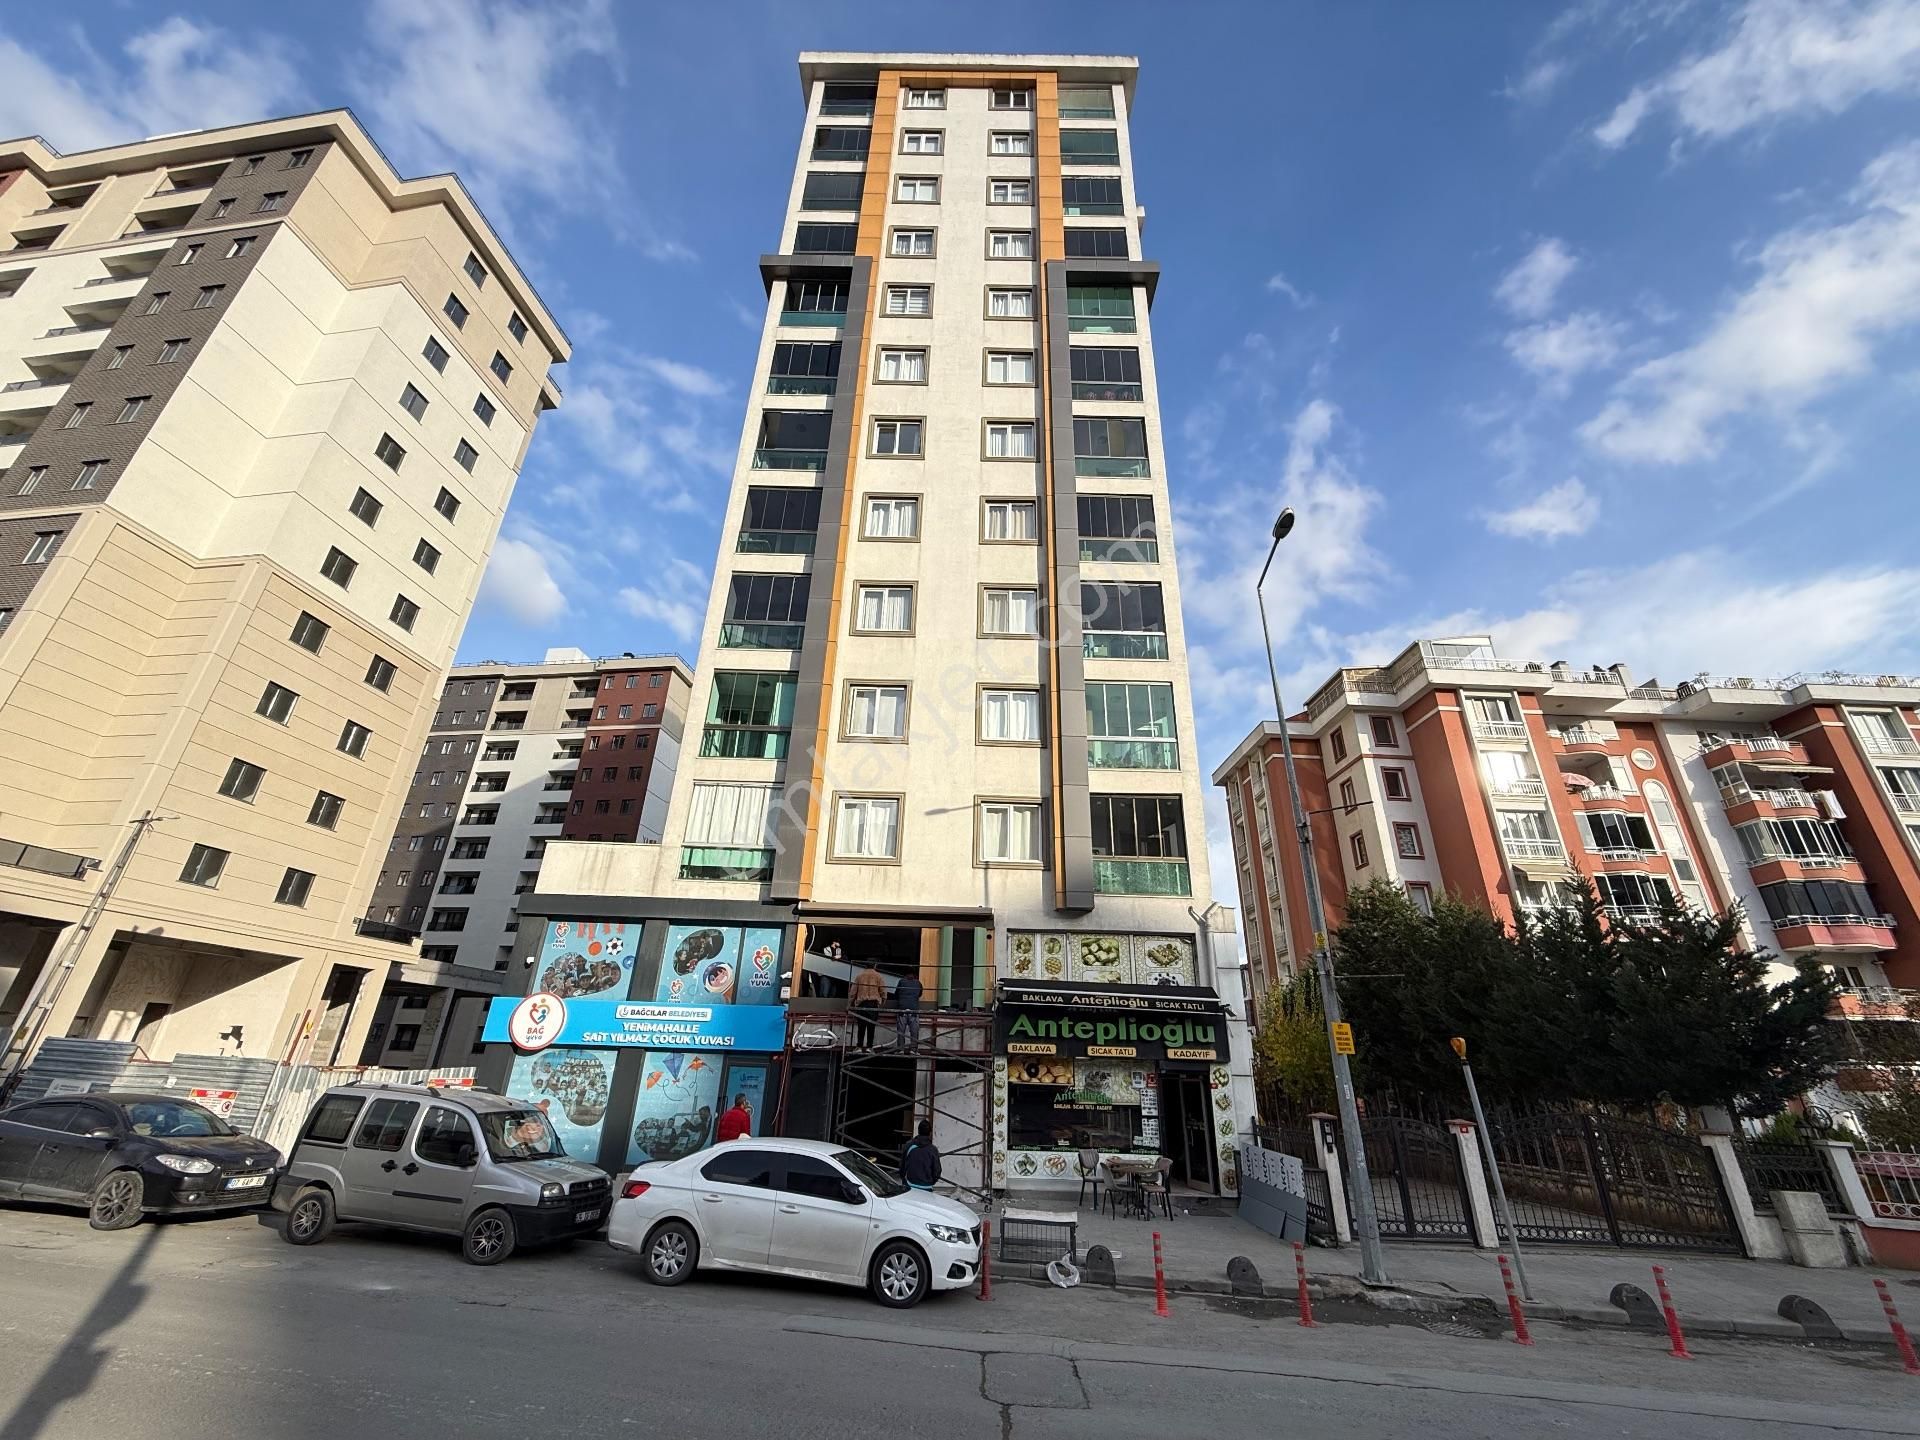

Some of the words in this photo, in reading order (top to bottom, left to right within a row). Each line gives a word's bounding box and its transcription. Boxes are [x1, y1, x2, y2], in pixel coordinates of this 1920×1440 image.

[1022, 994, 1064, 1003] BAKLAVA
[1070, 994, 1149, 1008] Anteplioğlu
[1155, 1001, 1181, 1010] SICAK
[1182, 1002, 1205, 1011] TATLI
[630, 1008, 668, 1017] BAĞCILAR
[526, 1026, 545, 1034] BAĞ
[1008, 1014, 1216, 1048] Anteplioğlu
[610, 1032, 650, 1044] YILMAZ
[652, 1034, 692, 1045] ÇOCUK
[693, 1035, 735, 1046] YUVASI
[1011, 1044, 1052, 1054] BAKLAVA
[1090, 1047, 1113, 1055] SICAK
[1114, 1048, 1134, 1056] TATLI
[1173, 1050, 1211, 1058] KADAYIF
